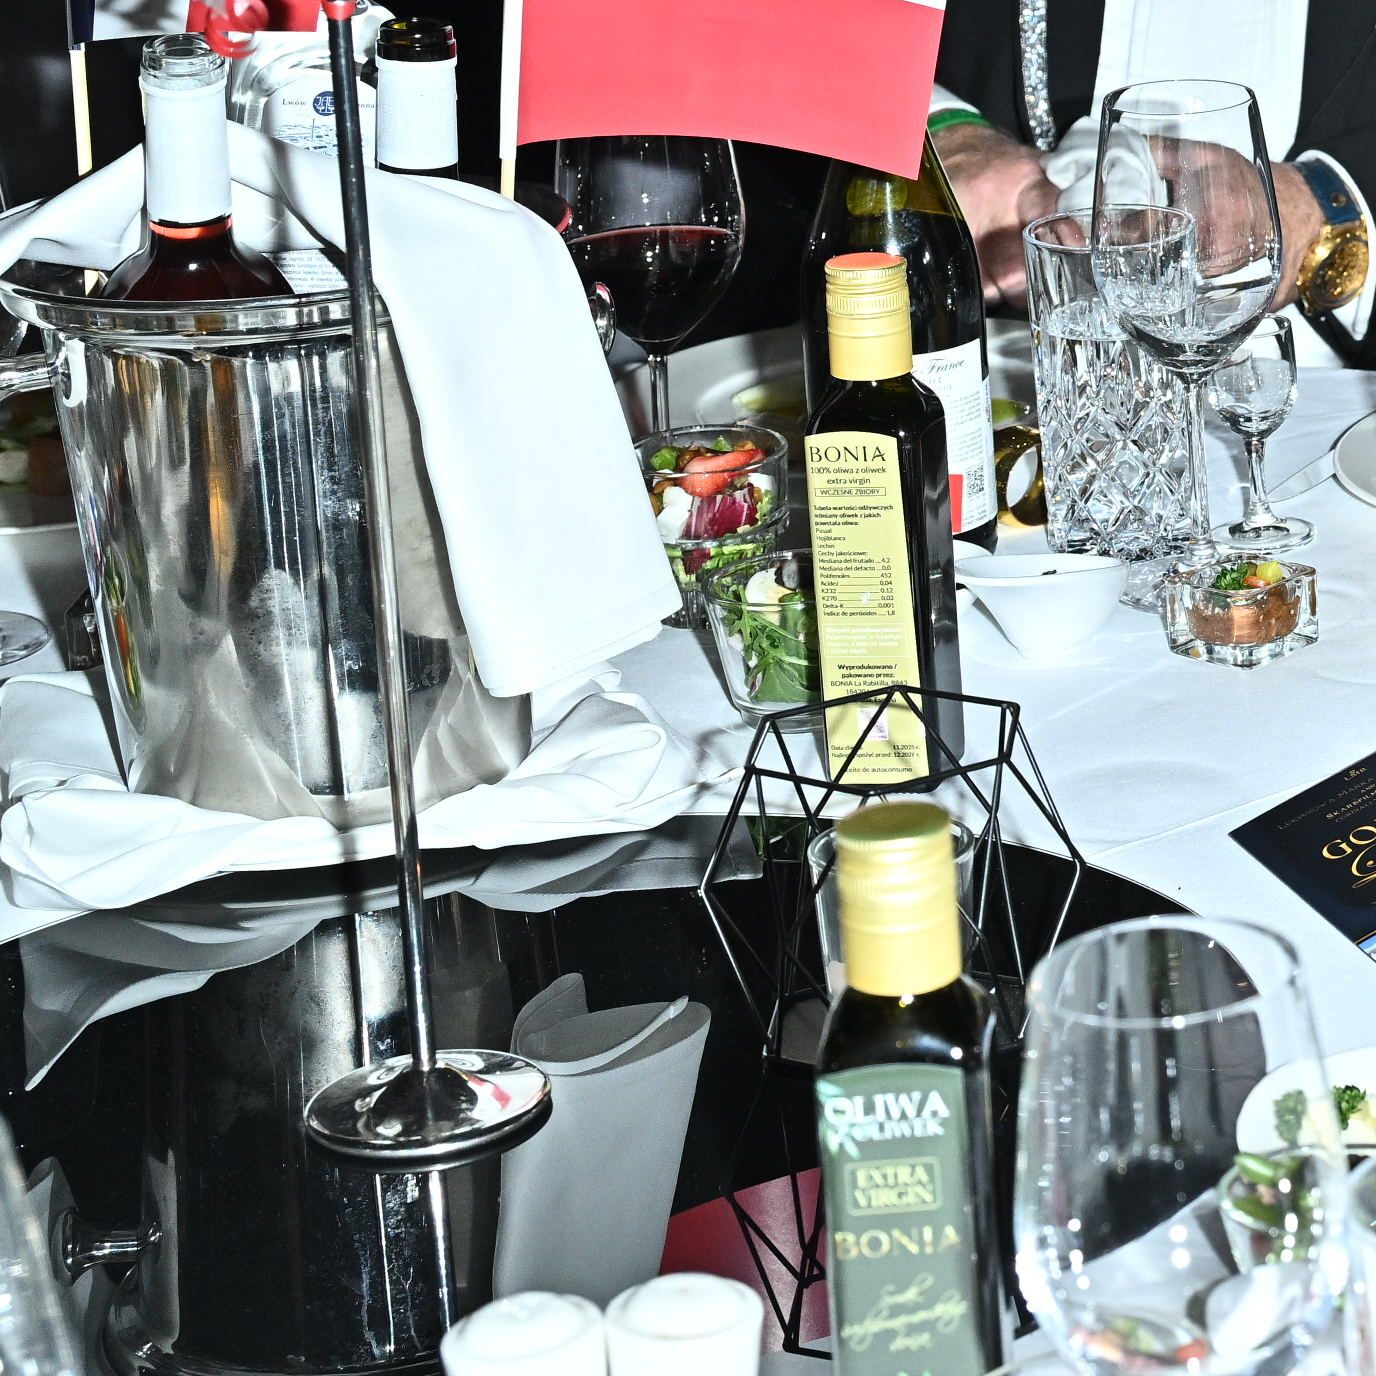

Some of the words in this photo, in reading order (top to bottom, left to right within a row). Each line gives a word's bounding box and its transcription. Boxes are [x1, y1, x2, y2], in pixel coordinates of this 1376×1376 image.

[282, 98, 307, 106] Lwów
[929, 358, 965, 374] France
[809, 446, 886, 463] BONIA
[810, 466, 832, 474] 100%
[833, 466, 854, 474] oliwa
[861, 466, 887, 474] oliwek
[826, 477, 847, 485] extra
[848, 477, 871, 485] virgin
[1360, 783, 1376, 794] AND
[824, 1089, 950, 1127] OLIWA
[856, 1165, 929, 1189] EXTRA
[854, 1183, 935, 1208] VIRGIN
[834, 1225, 961, 1260] BONIA
